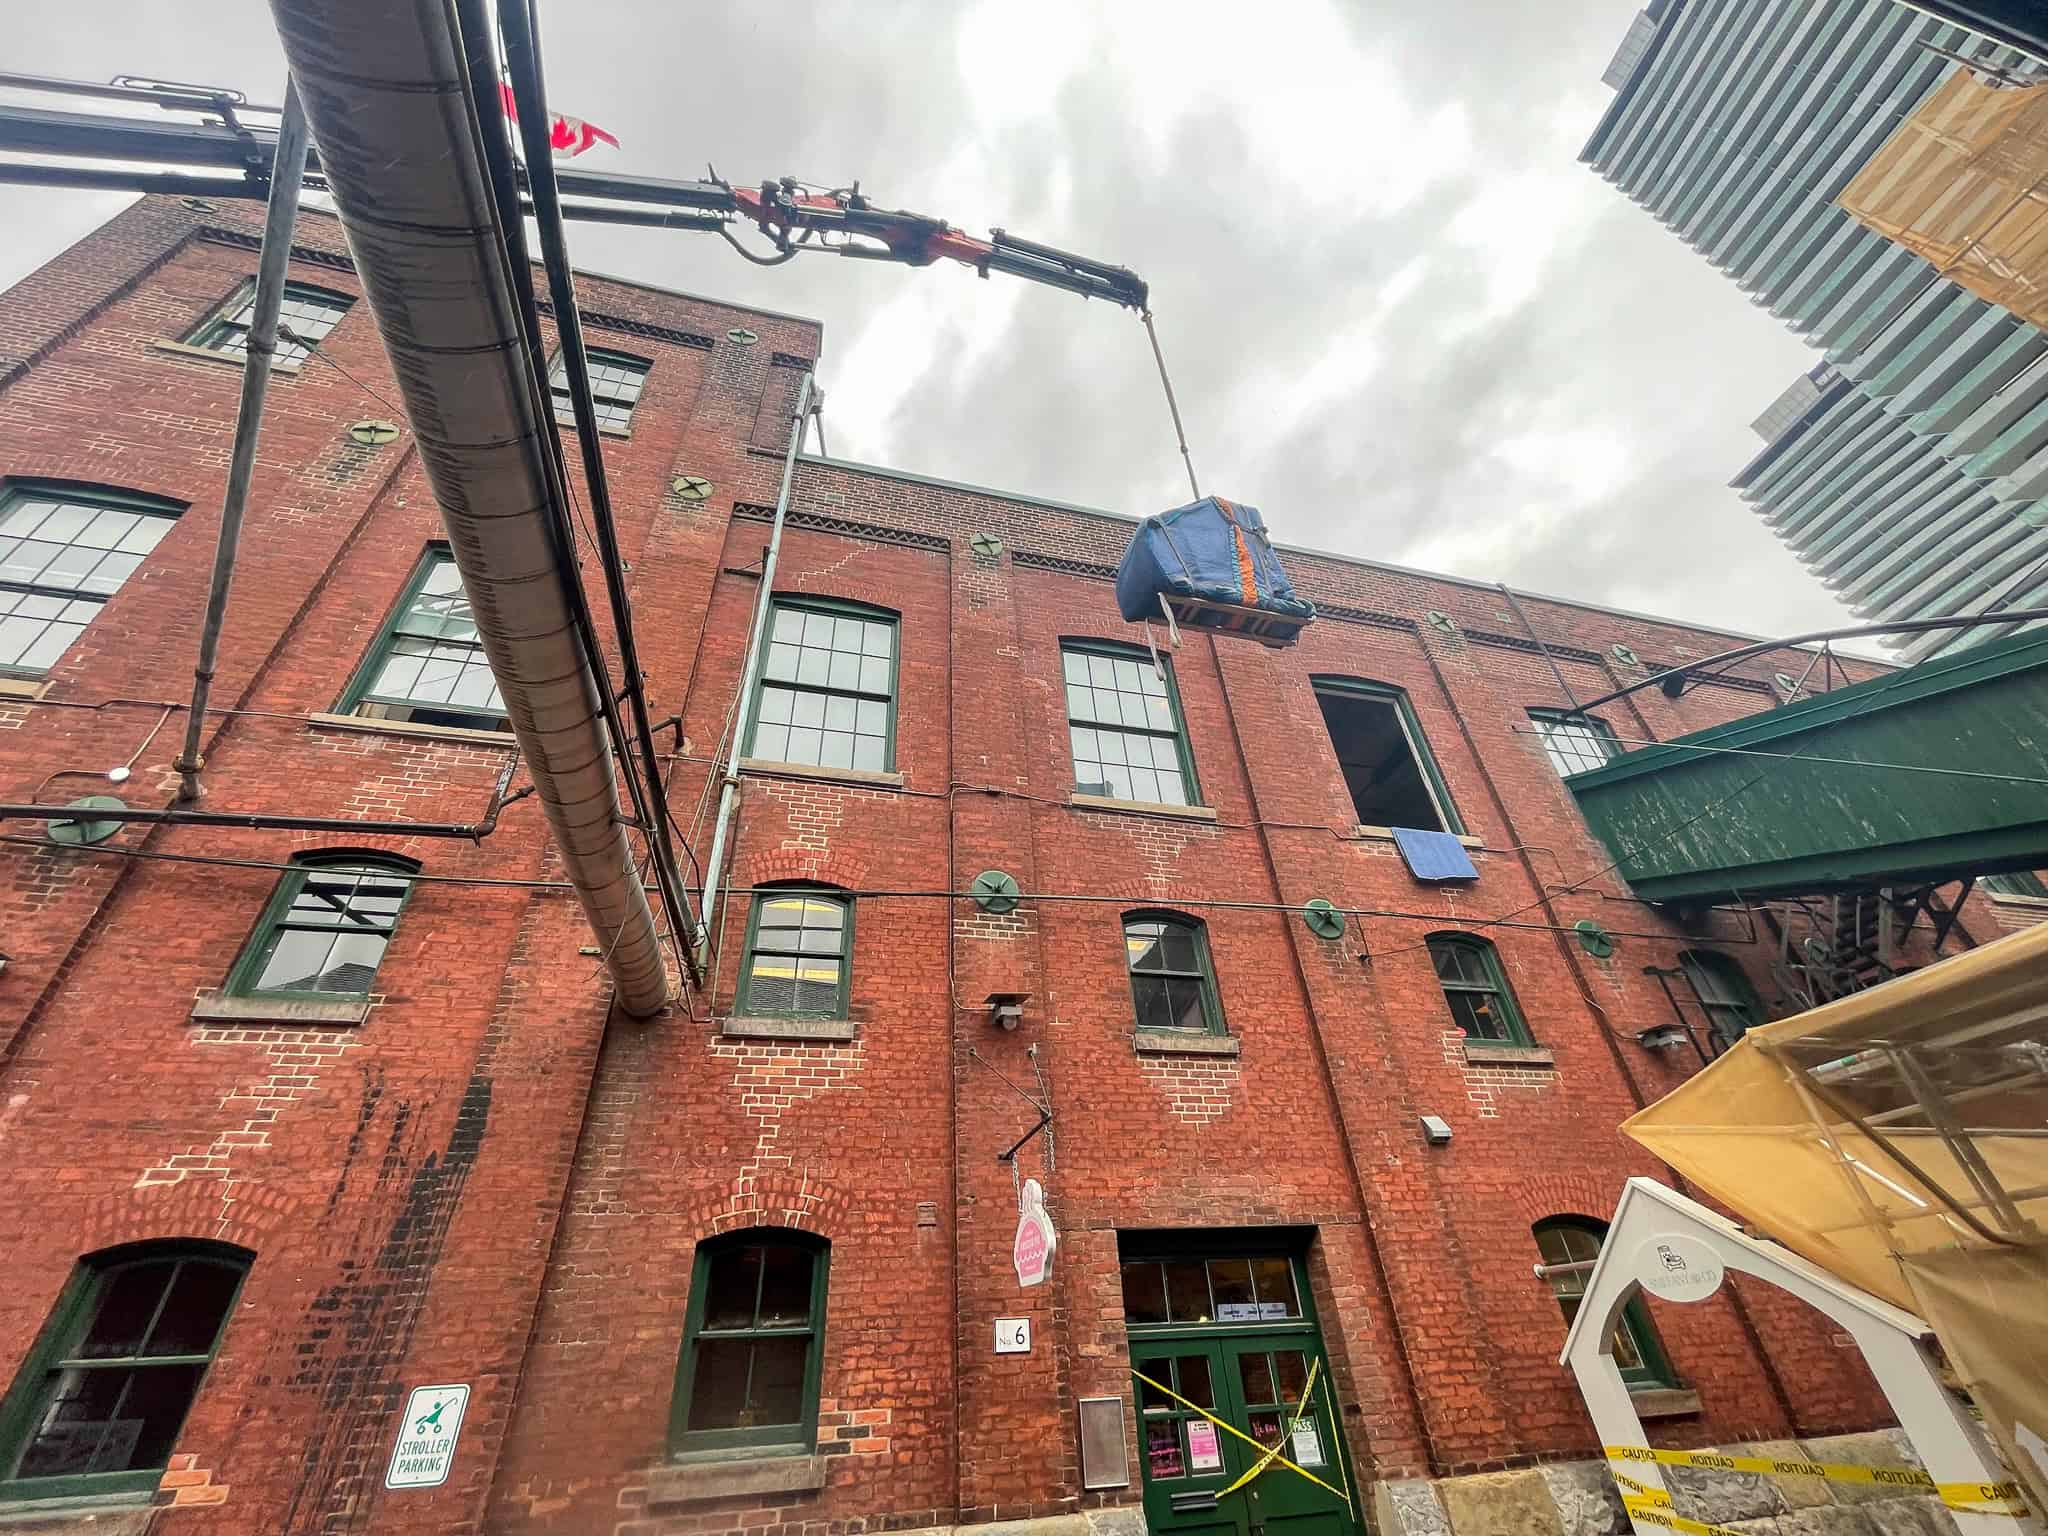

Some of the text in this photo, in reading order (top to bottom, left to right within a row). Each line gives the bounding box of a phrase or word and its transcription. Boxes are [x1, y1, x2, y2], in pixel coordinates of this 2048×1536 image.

[1015, 1325, 1026, 1345] 6
[400, 1439, 450, 1456] STROLLER
[397, 1456, 443, 1474] PARKING
[1631, 1508, 1673, 1527] CAUTION
